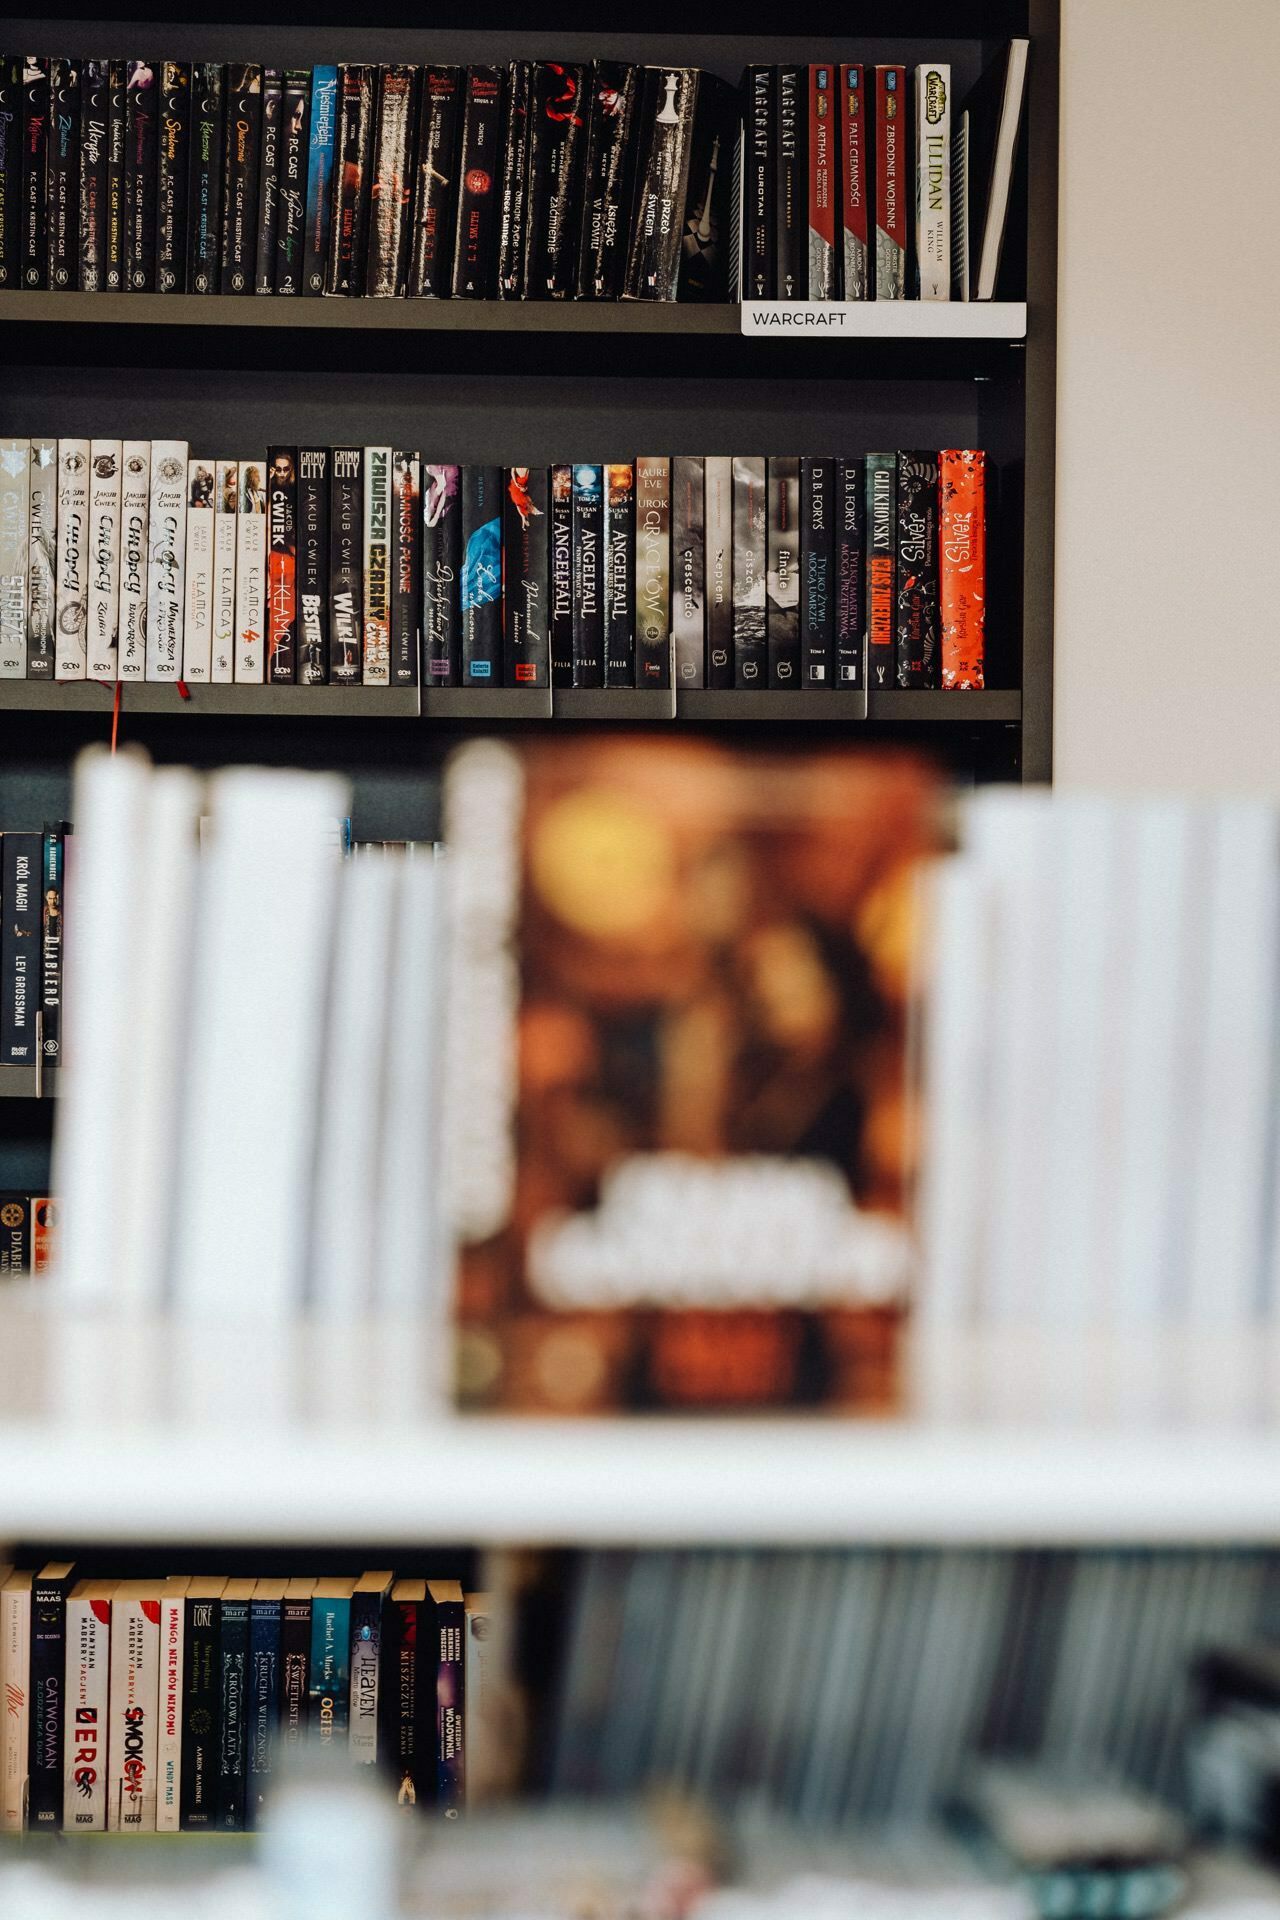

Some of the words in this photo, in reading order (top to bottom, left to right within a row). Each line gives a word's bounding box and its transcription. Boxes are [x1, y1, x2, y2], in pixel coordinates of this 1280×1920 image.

[754, 72, 769, 158] WARCRAFT
[781, 73, 796, 158] WARCRAFT
[927, 77, 939, 118] WARCRAFT
[84, 120, 105, 164] Ukryta
[266, 127, 275, 142] P.C.
[289, 138, 298, 154] P.C.
[817, 124, 826, 166] ARTHAS
[849, 122, 858, 146] FALE
[886, 125, 895, 177] ZBRODNIE
[266, 145, 275, 167] CAST
[289, 157, 298, 179] CAST
[926, 135, 944, 211] ILLIDAN
[850, 148, 861, 207] CIEMNOŚCI
[885, 180, 895, 229] WOJENNE
[935, 221, 943, 262] WILLIAM
[752, 313, 846, 325] WARCRAFT
[300, 463, 325, 479] CITY
[301, 452, 325, 463] GRIMM
[334, 451, 359, 462] GRIMM
[334, 462, 359, 478] CITY
[638, 468, 668, 479] LAURE
[812, 469, 822, 481] D.
[845, 470, 855, 479] D.
[158, 491, 182, 500] JAKUB
[371, 452, 387, 540] ZAWISZA
[638, 500, 668, 508] UROK
[644, 480, 662, 488] EVE
[812, 483, 822, 492] B.
[845, 484, 855, 493] B.
[272, 490, 286, 545] ĆWIEK
[308, 485, 317, 531] JAKUB
[342, 484, 350, 530] JAKUB
[812, 495, 824, 530] FORYŚ
[845, 496, 857, 531] FORYŚ
[873, 470, 890, 550] GLUKHOVSKY
[900, 513, 926, 562] Silver
[944, 513, 970, 563] Silver
[308, 540, 319, 585] ĆWIEK
[342, 538, 353, 584] ĆWIEK
[400, 547, 411, 594] PŁONIE
[554, 522, 570, 621] ANGELFALL
[581, 528, 596, 619] ANGELFALL
[612, 530, 628, 620] ANGELFALL
[714, 549, 724, 603] szeptem
[745, 550, 755, 584] cisza
[779, 550, 790, 589] finale
[806, 552, 817, 584] MOGĄ
[817, 559, 826, 591] TYLKO
[838, 544, 850, 576] MOGĄ
[849, 550, 859, 585] TYLKO
[871, 559, 887, 585] CZAS
[220, 567, 232, 627] KŁAMCA
[248, 567, 258, 627] KŁAMCA
[370, 544, 387, 621] CZARNY
[426, 561, 454, 632] Dziedzictwo
[684, 550, 694, 618] crescendo
[97, 601, 108, 637] ZGUBA
[301, 594, 322, 642] BESTIE
[333, 592, 357, 644] WILK!
[428, 608, 444, 642] mroku
[469, 592, 482, 641] utracona
[521, 580, 540, 640] Podarunek
[808, 586, 819, 630] UMRZEĆ
[817, 594, 828, 622] ŻYWI
[840, 579, 850, 640] PRZETRWAĆ
[849, 586, 858, 631] MARTWI
[870, 588, 891, 644] ZMIERZCHU
[126, 602, 137, 658] BANGARANG
[215, 630, 231, 640] 3
[241, 629, 260, 644] 4
[366, 623, 378, 662] ĆWIEK
[378, 623, 389, 660] JAKUB
[16, 856, 30, 882] KRÓL
[15, 884, 28, 911] MAGII
[15, 956, 26, 972] LEV
[44, 936, 60, 1006] DIABLERO
[14, 976, 25, 1026] GROSSMAN
[88, 1617, 96, 1670] JONATHAN
[128, 1617, 136, 1662] MABERRY
[136, 1617, 144, 1669] JONATHAN
[168, 1608, 178, 1646] MANGO,
[325, 1612, 336, 1641] Rachel
[168, 1648, 177, 1666] NIE
[324, 1655, 334, 1680] Marks
[325, 1643, 334, 1653] A.
[79, 1664, 87, 1706] PACJENT
[167, 1669, 179, 1691] MÓW
[227, 1672, 239, 1725] KRÓLOWA
[258, 1657, 269, 1701] KRUCHA
[289, 1664, 301, 1725] ŚWIETLISTE
[400, 1651, 411, 1719] MISZCZUK
[5, 1683, 25, 1719] Moc
[166, 1694, 177, 1735] NIKOMU
[45, 1677, 58, 1769] CATWOMAN
[227, 1730, 237, 1756] LATA
[445, 1708, 454, 1759] WOJOWNIK
[36, 1740, 44, 1766] DUSZ
[121, 1706, 147, 1793] SMOKÓW
[165, 1760, 174, 1784] WENDY
[165, 1786, 174, 1806] MASS
